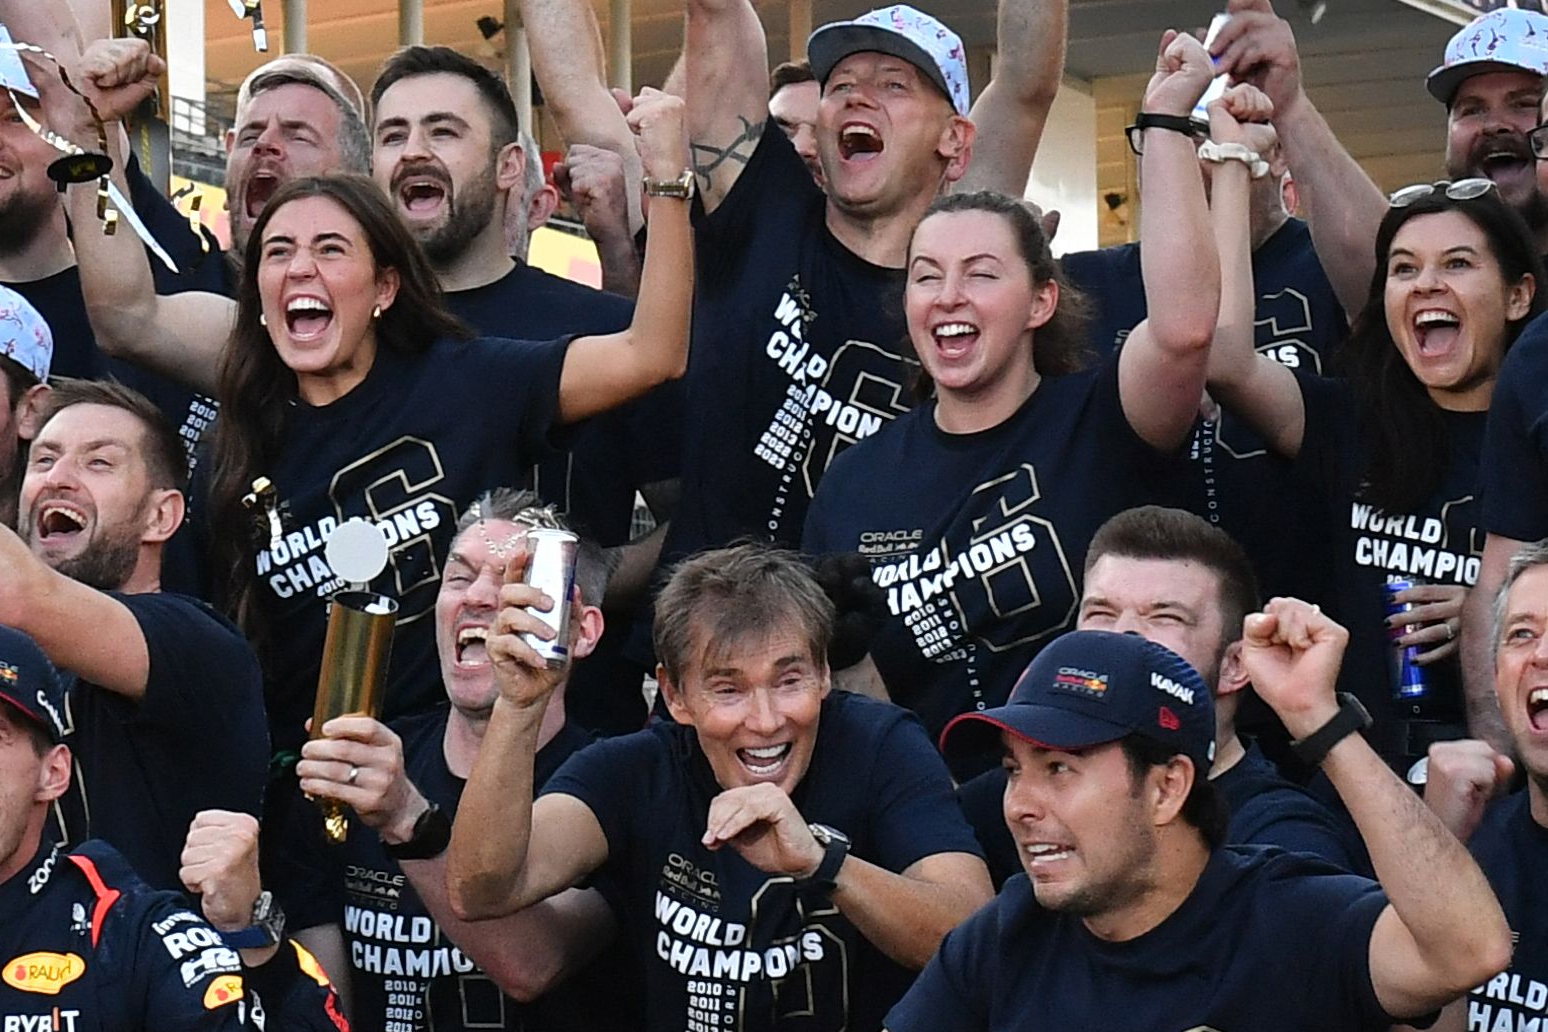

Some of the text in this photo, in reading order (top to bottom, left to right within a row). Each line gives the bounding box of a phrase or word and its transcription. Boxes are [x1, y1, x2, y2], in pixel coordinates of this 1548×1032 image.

[769, 421, 798, 446] 2013
[774, 409, 803, 435] 2012
[754, 444, 786, 470] 2023
[760, 432, 793, 459] 2022
[860, 530, 923, 542] ORACLE
[270, 501, 441, 599] CHAONS
[1355, 536, 1483, 586] CHAMPIO
[1151, 671, 1195, 705] KAVAK
[346, 865, 405, 886] ORACLE
[345, 904, 432, 943] WORLD
[655, 891, 745, 947] WORLD
[163, 927, 223, 960] RO
[657, 931, 824, 982] CHAMPOS
[385, 979, 418, 992] 2010
[687, 981, 723, 996] 2010
[1471, 971, 1548, 1010] RLD
[388, 993, 416, 1006] 2011
[689, 995, 720, 1011] 2011
[385, 1007, 414, 1020] 2012
[688, 1007, 720, 1024] 2012
